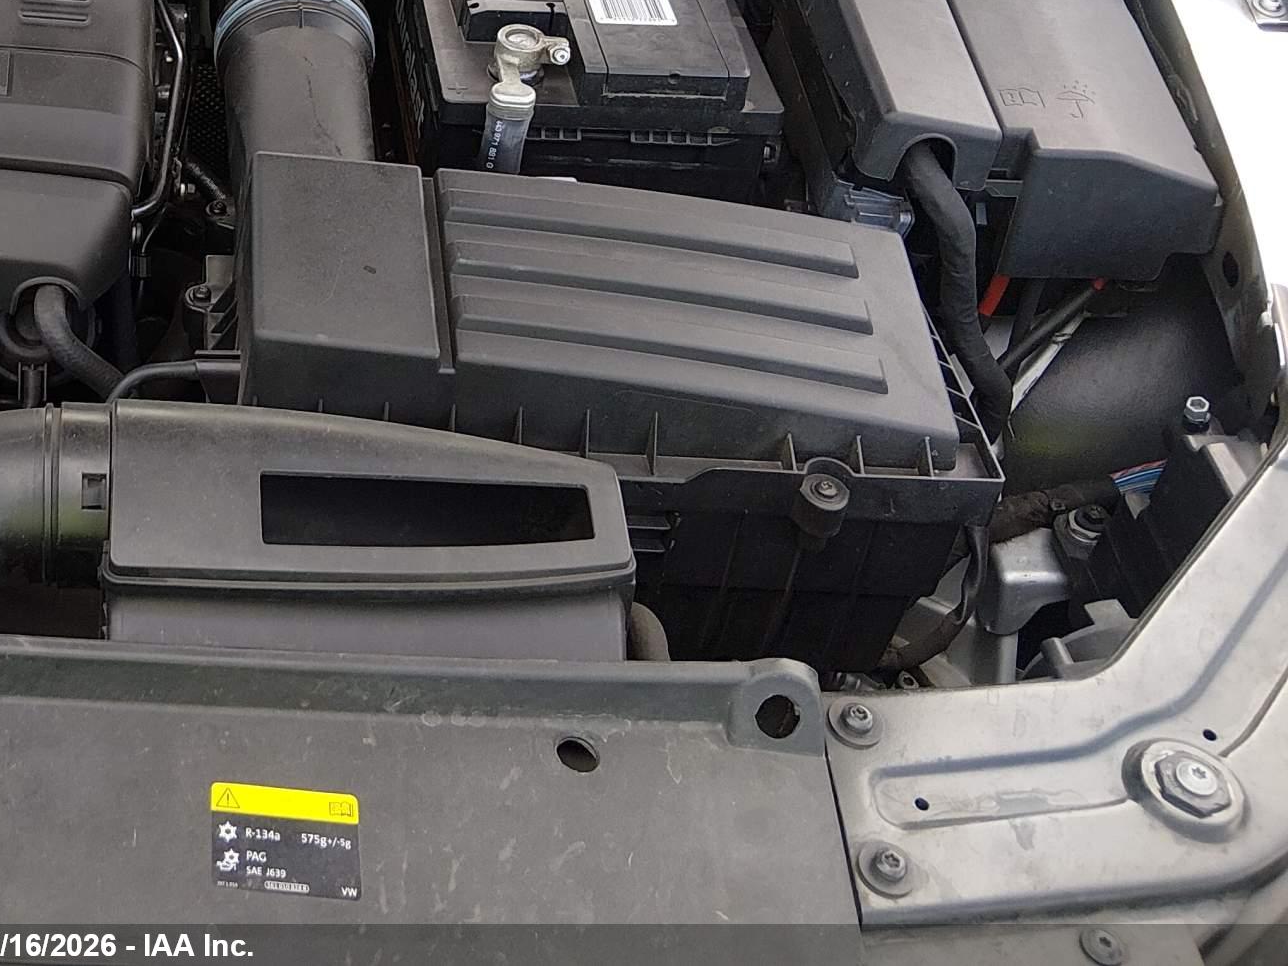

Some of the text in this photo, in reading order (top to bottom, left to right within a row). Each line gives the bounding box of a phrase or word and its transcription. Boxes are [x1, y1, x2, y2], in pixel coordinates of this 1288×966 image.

[245, 827, 281, 841] R-134a
[246, 850, 267, 863] PAG
[246, 866, 287, 879] SAE J639
[341, 886, 358, 897] VW
